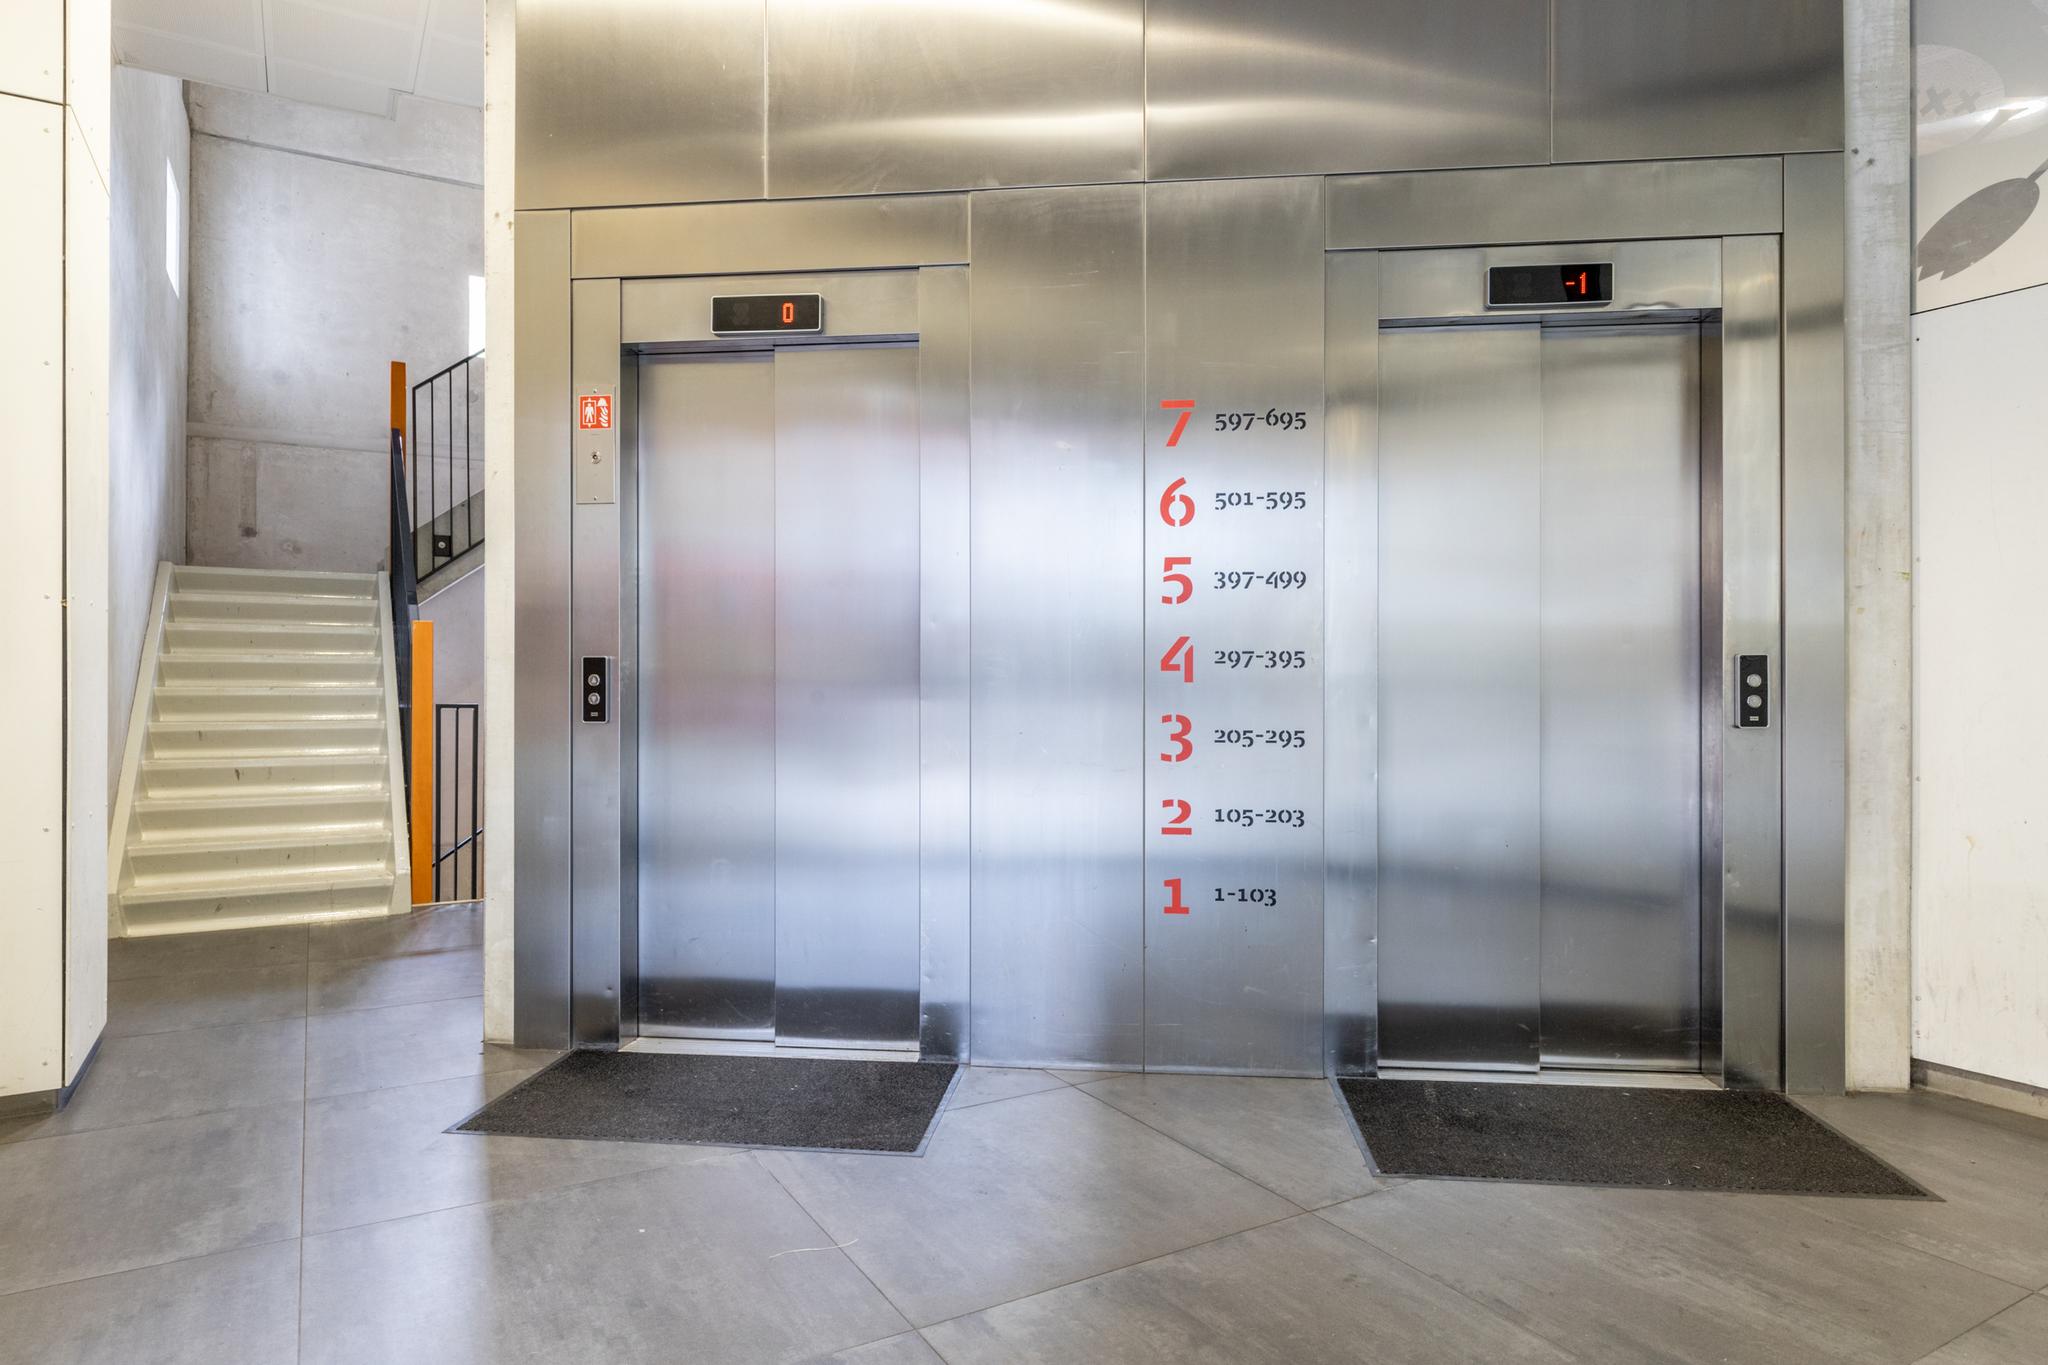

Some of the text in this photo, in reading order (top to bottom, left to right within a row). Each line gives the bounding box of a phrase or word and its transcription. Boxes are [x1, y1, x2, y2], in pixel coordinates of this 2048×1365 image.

[1565, 271, 1587, 294] -1
[782, 302, 794, 323] 0
[1160, 400, 1307, 447] 7 597-695
[1160, 477, 1306, 527] 6 501-595
[1161, 557, 1307, 605] 5 397-499
[1160, 636, 1306, 683] 4 297-395
[1160, 714, 1306, 762] 3 205-295
[1161, 799, 1305, 836] 2 105-203
[1163, 878, 1277, 915] 1 1-103
